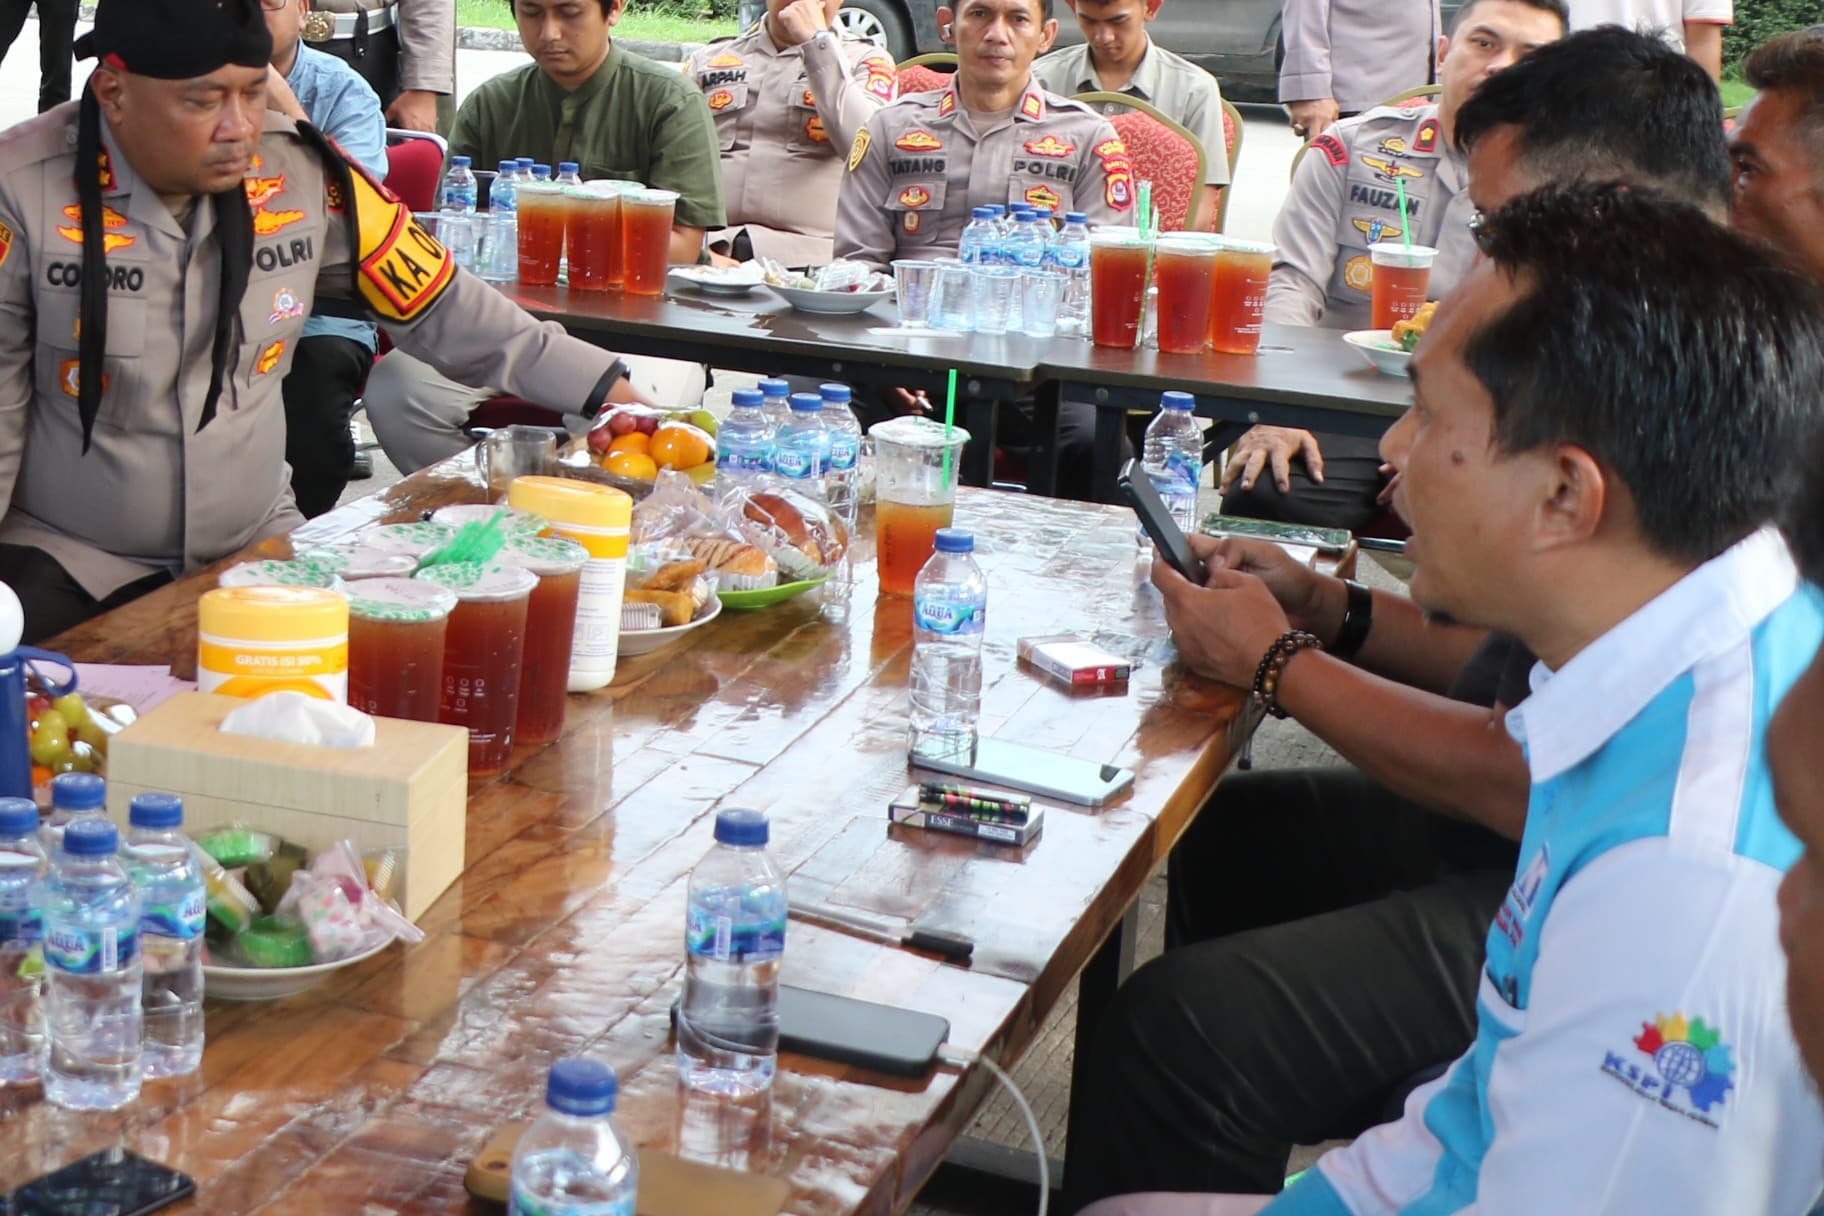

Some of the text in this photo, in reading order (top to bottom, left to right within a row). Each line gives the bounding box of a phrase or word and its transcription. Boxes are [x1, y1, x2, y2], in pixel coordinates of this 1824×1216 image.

[889, 158, 1077, 183] TATANG POLRI
[47, 236, 314, 292] CODRO OLRI
[379, 248, 432, 300] KA
[922, 604, 953, 620] AQUA
[235, 654, 278, 666] GRATIS
[929, 815, 954, 828] ESSE
[1603, 1050, 1674, 1100] KSPI
